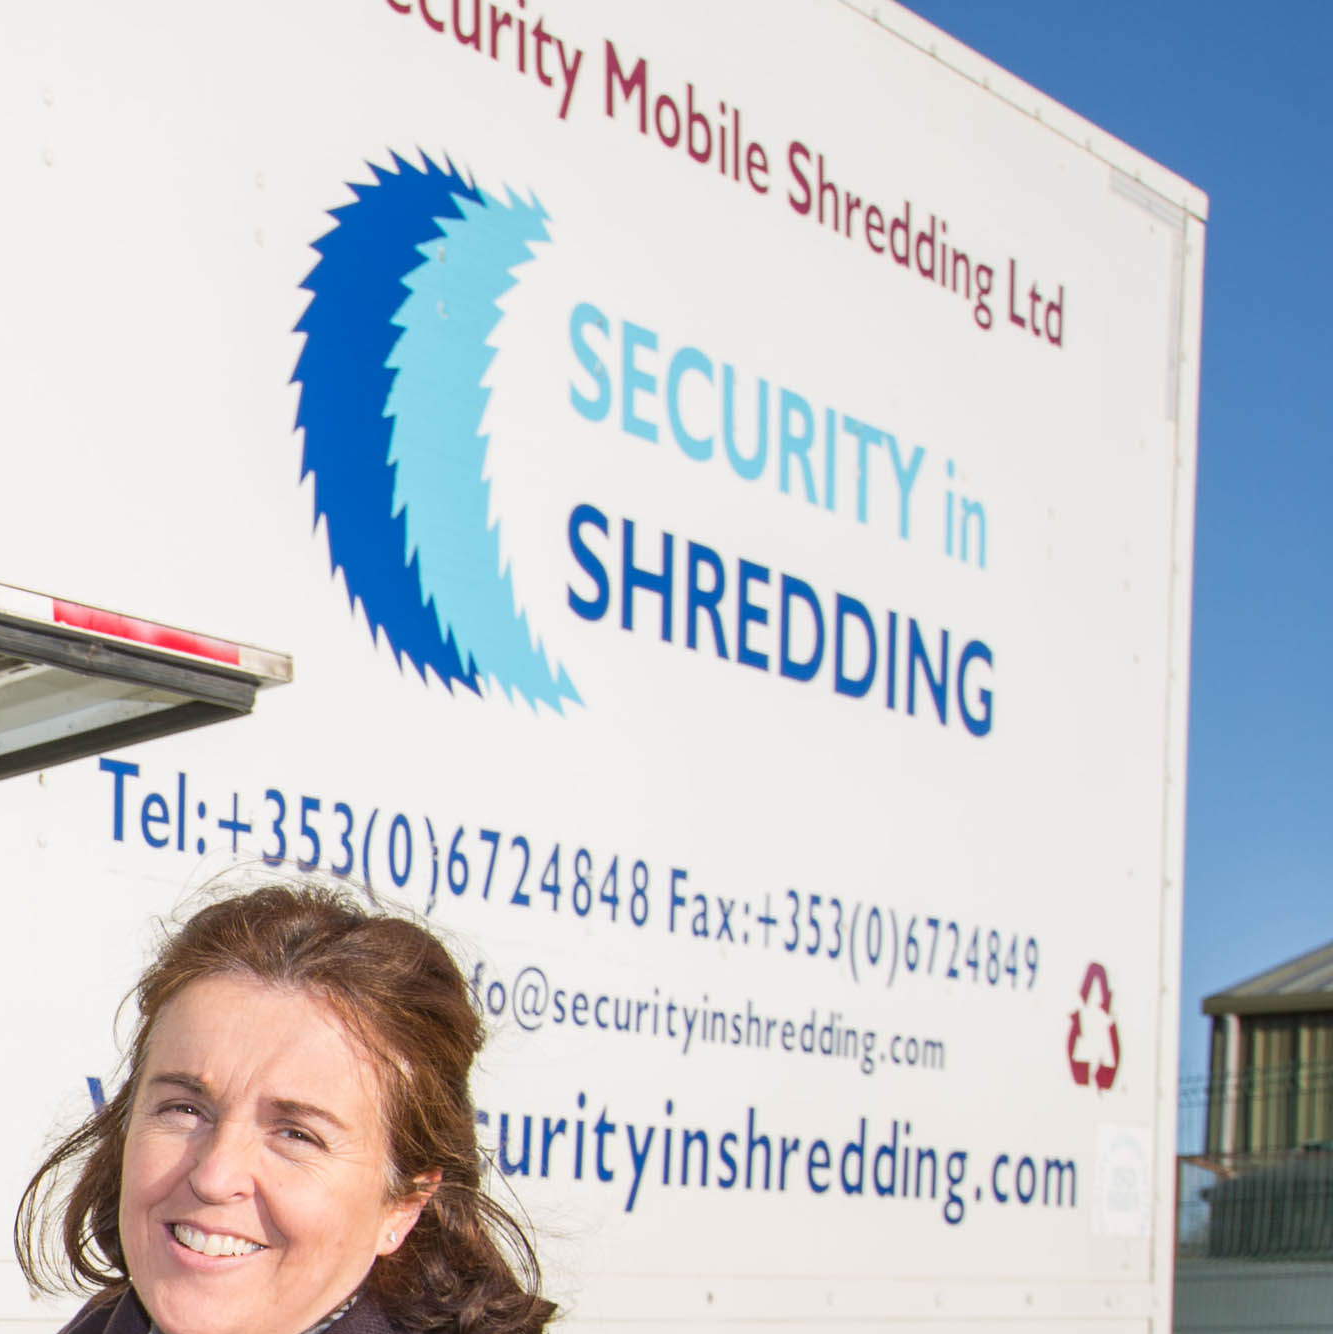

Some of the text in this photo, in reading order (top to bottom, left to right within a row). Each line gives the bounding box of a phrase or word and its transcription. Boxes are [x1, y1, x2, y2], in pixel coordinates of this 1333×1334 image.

[385, 0, 1064, 348] curity Mobile Shredding Ltd
[569, 302, 987, 569] SECURITY in
[567, 503, 994, 738] SHREDDING
[669, 868, 1039, 990] Fax:+353(0)6724849
